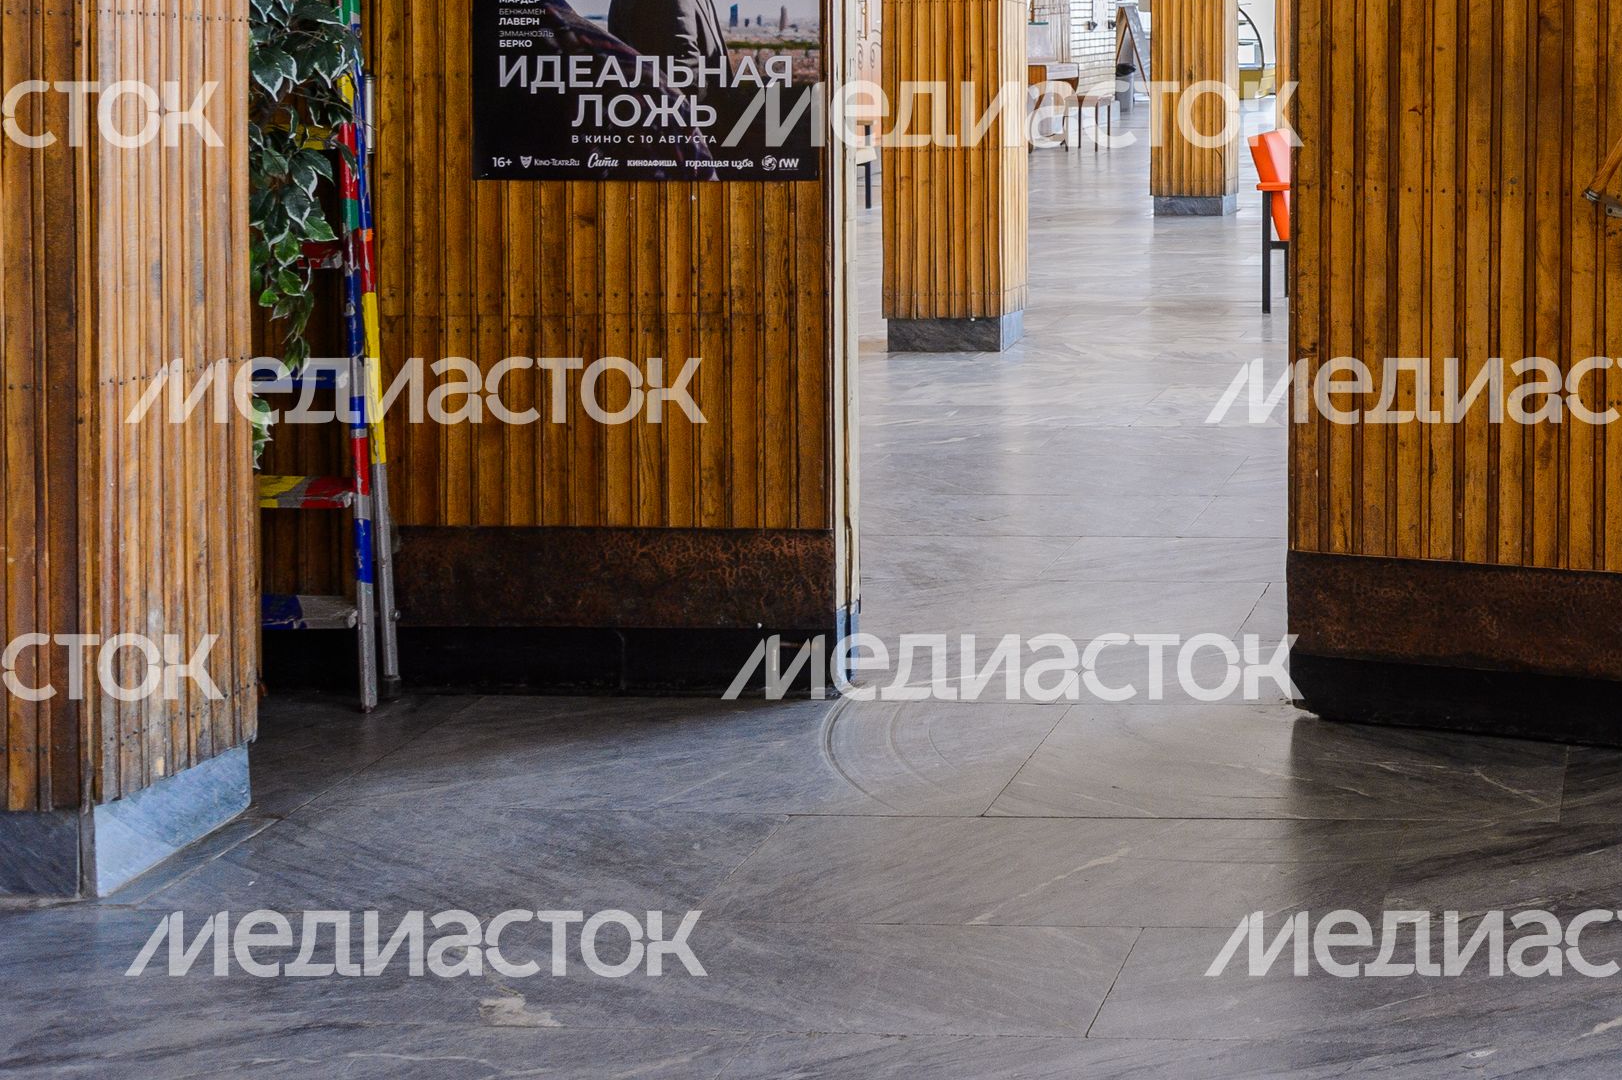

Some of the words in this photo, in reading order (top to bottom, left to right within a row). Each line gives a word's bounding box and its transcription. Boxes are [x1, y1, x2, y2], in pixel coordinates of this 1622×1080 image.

[498, 18, 540, 26] ЛАВЕРН
[499, 30, 554, 38] ЭММАНЮЭЛЬ
[499, 40, 533, 48] БЕРКО
[499, 55, 792, 94] ИДЕАЛЬНАЯ
[571, 94, 717, 128] ЛОЖЬ
[571, 135, 579, 144] В
[585, 135, 622, 144] КИНО
[627, 135, 635, 144] С
[640, 135, 654, 144] 10
[659, 135, 717, 144] АВГУСТА
[492, 157, 512, 167] 16+
[627, 159, 677, 167] КИНОАФИША
[685, 159, 729, 169] горящая
[731, 158, 754, 169] изба
